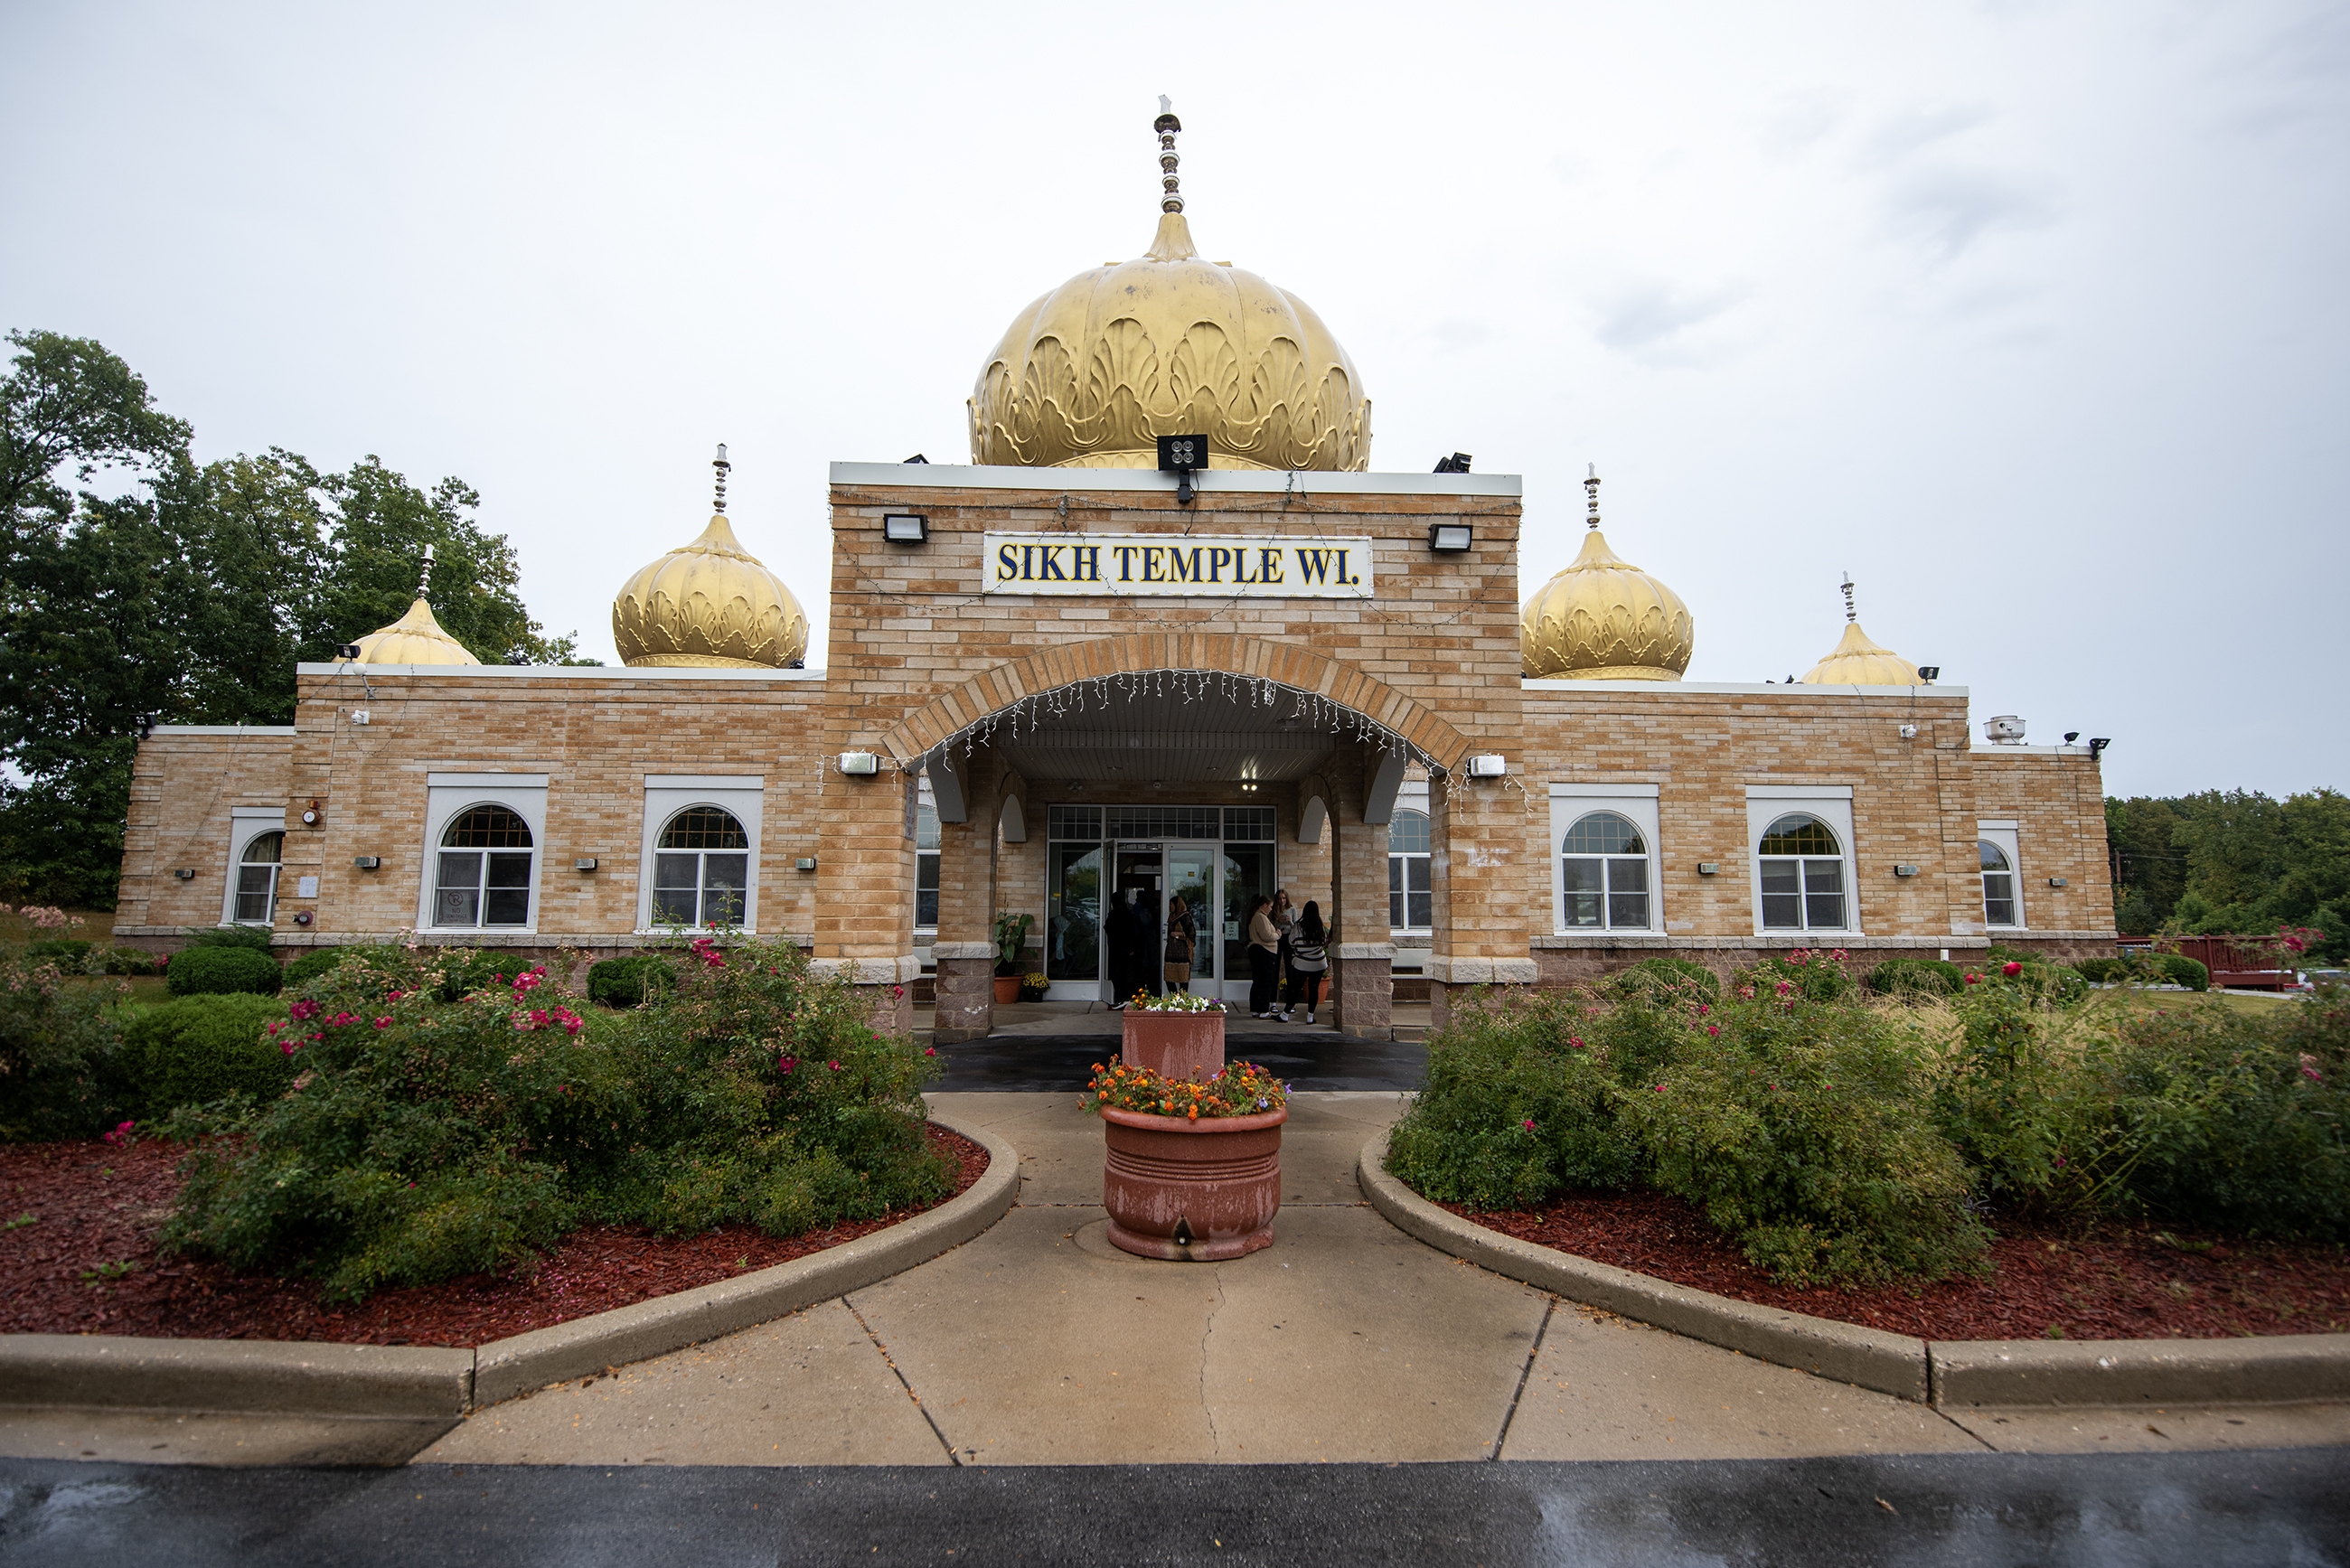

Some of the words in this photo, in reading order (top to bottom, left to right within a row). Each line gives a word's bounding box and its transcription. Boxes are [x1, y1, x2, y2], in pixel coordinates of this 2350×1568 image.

[996, 542, 1102, 582] SIKH
[1113, 545, 1284, 585] TEMPLE
[1293, 548, 1360, 586] WI.
